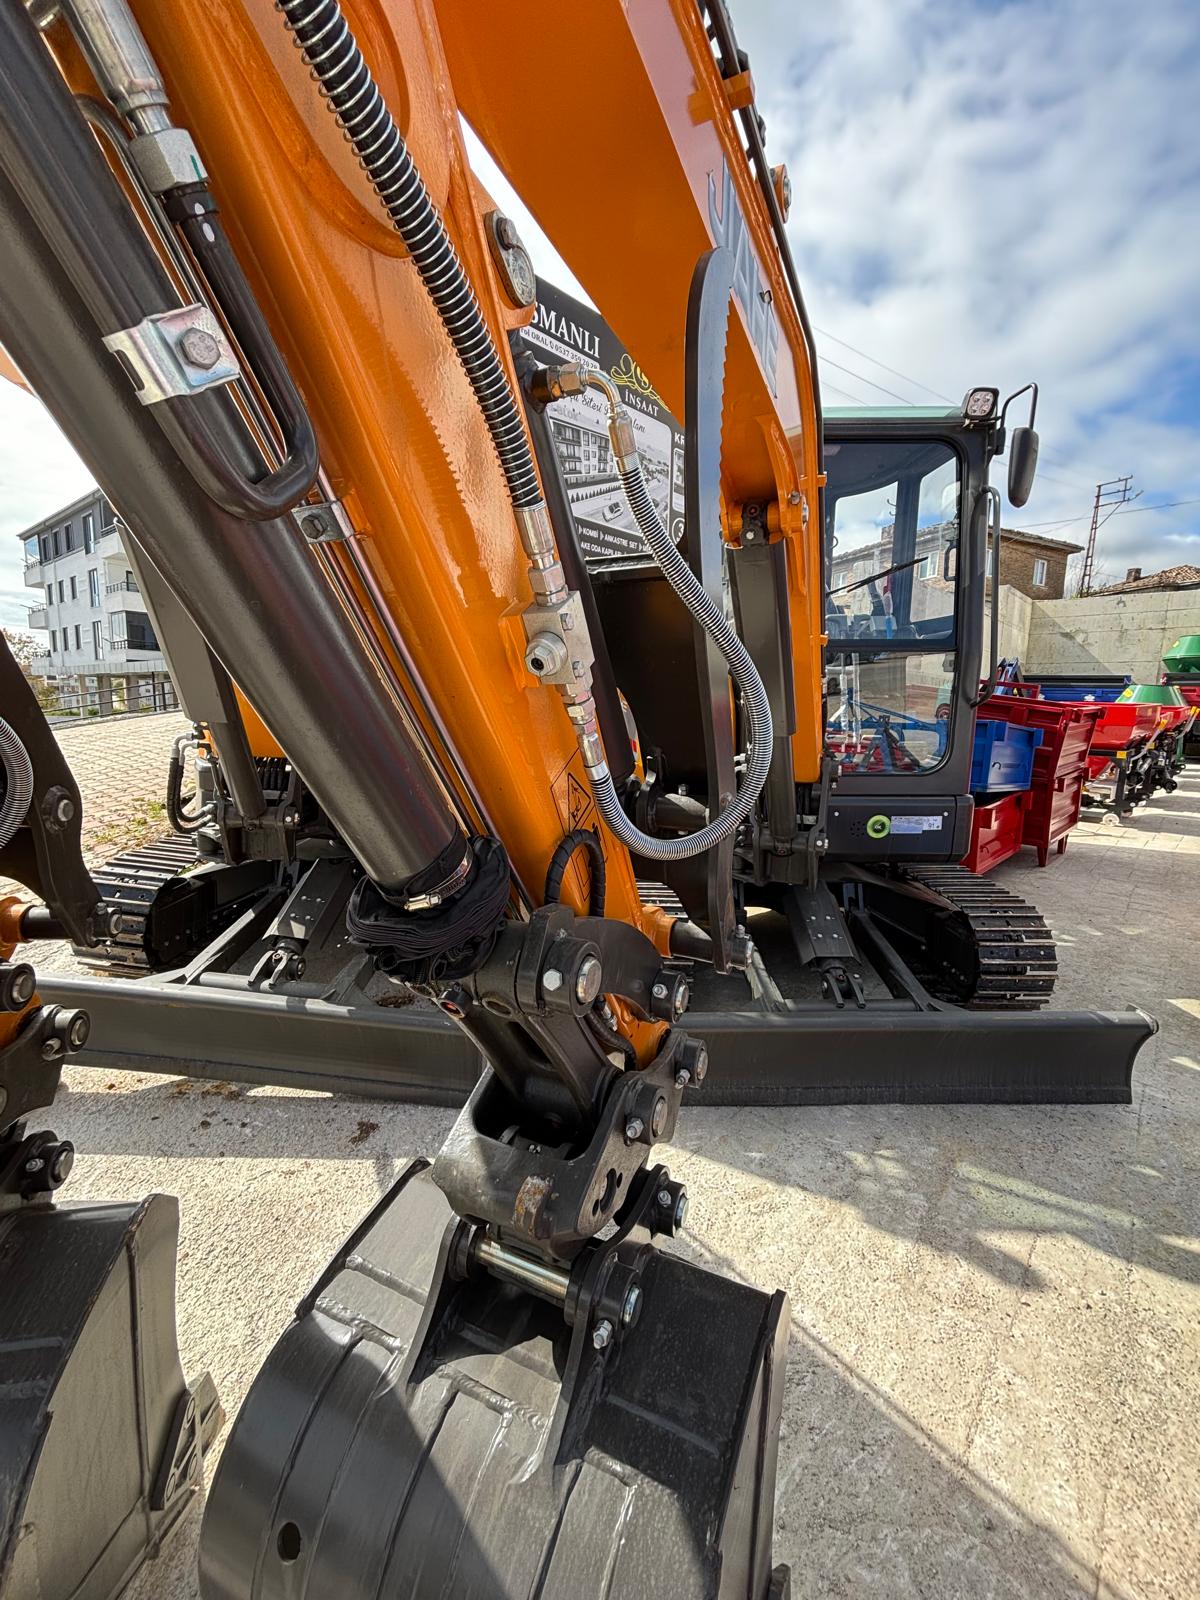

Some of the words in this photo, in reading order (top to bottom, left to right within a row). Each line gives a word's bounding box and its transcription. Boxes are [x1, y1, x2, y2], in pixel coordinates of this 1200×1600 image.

[531, 332, 549, 346] ORAL
[554, 344, 570, 357] 0537
[581, 394, 602, 412] Sitesi
[625, 389, 659, 416] İNŞAAT
[582, 527, 599, 539] KOMBİ
[604, 533, 628, 547] ANKASTRE
[628, 540, 638, 549] SET
[591, 543, 602, 553] ODA
